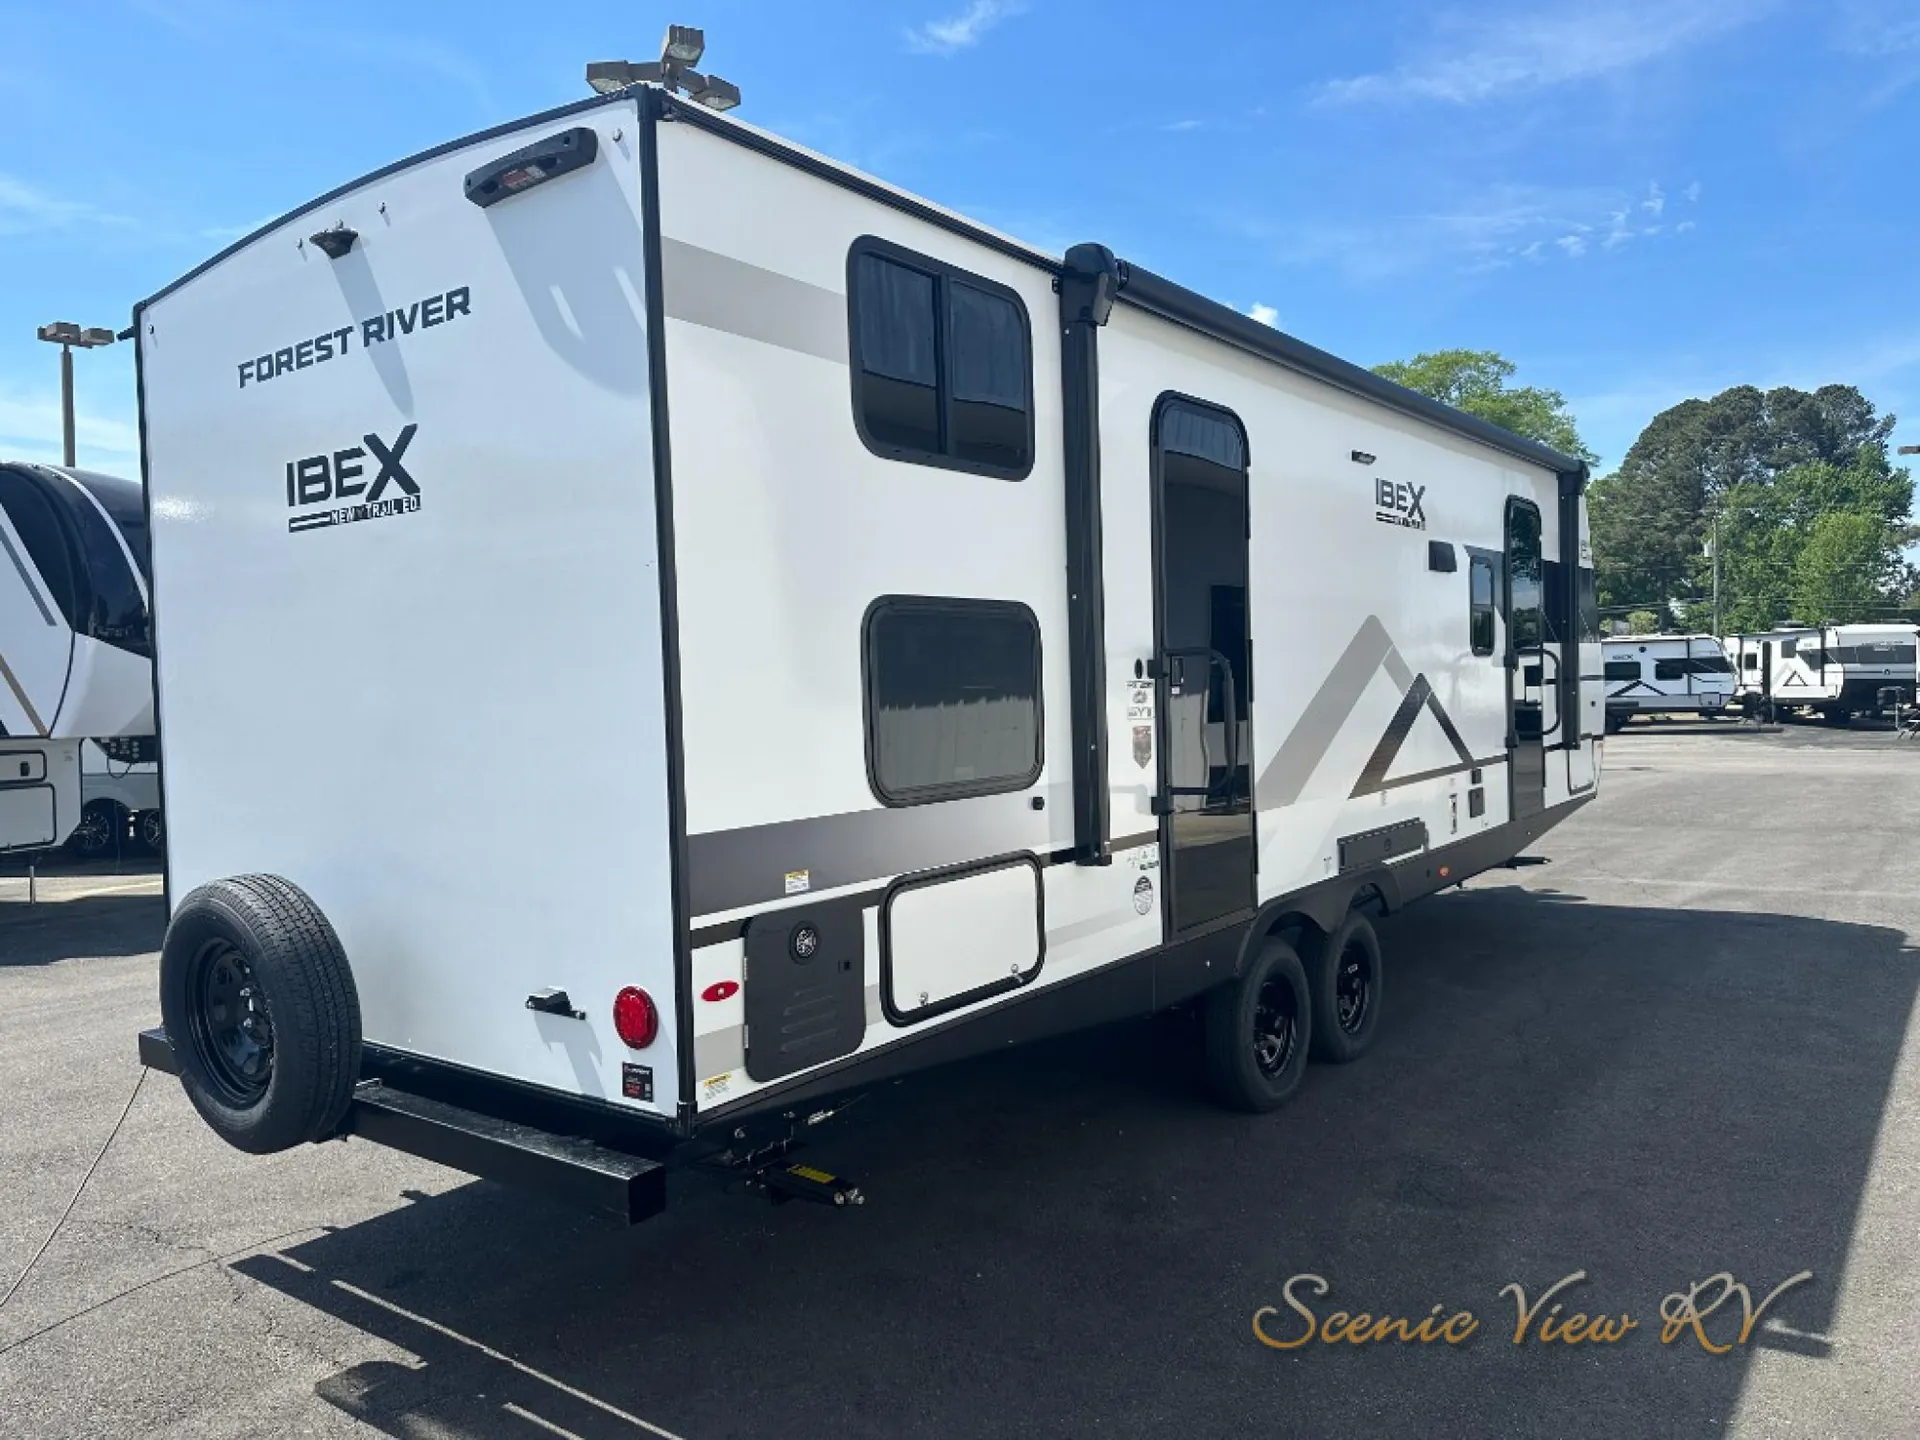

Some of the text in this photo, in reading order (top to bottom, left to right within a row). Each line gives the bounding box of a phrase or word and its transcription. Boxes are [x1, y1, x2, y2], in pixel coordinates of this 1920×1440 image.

[237, 286, 471, 389] FOREST RIVER
[286, 423, 421, 507] IBEX
[1375, 477, 1426, 520] IBEX
